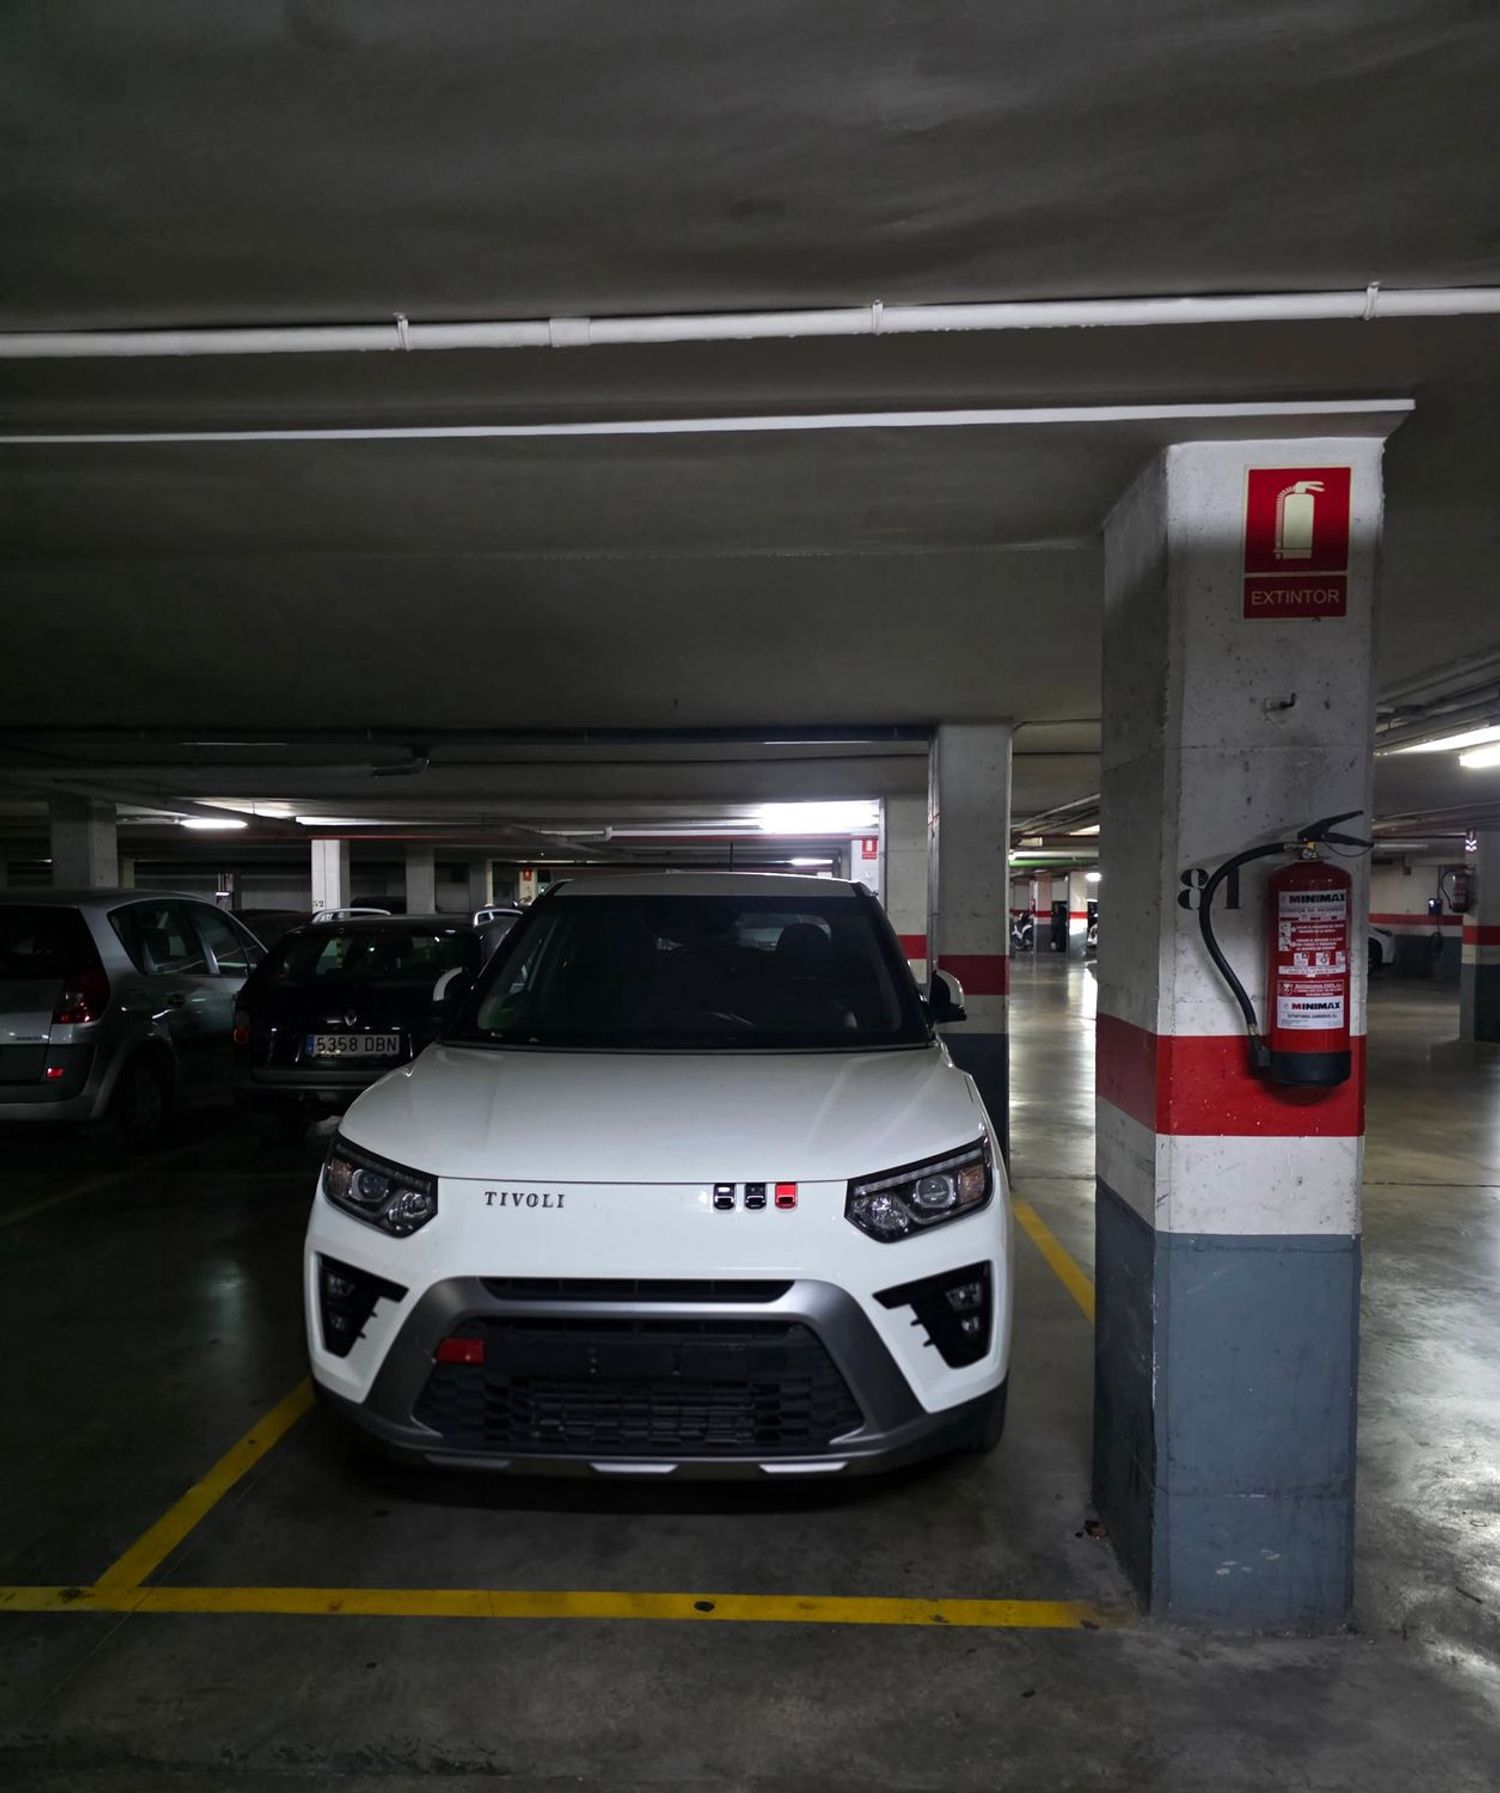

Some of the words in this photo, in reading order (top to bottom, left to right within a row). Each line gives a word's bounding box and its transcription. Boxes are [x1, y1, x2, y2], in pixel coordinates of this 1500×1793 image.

[1251, 589, 1340, 605] EXTINTOR
[1178, 868, 1241, 910] 81
[1289, 893, 1345, 904] MINIMAX
[1291, 1002, 1340, 1011] MINIMAX
[317, 1037, 358, 1052] 5358
[364, 1037, 397, 1052] DBN
[485, 1191, 565, 1209] TIVOLI
